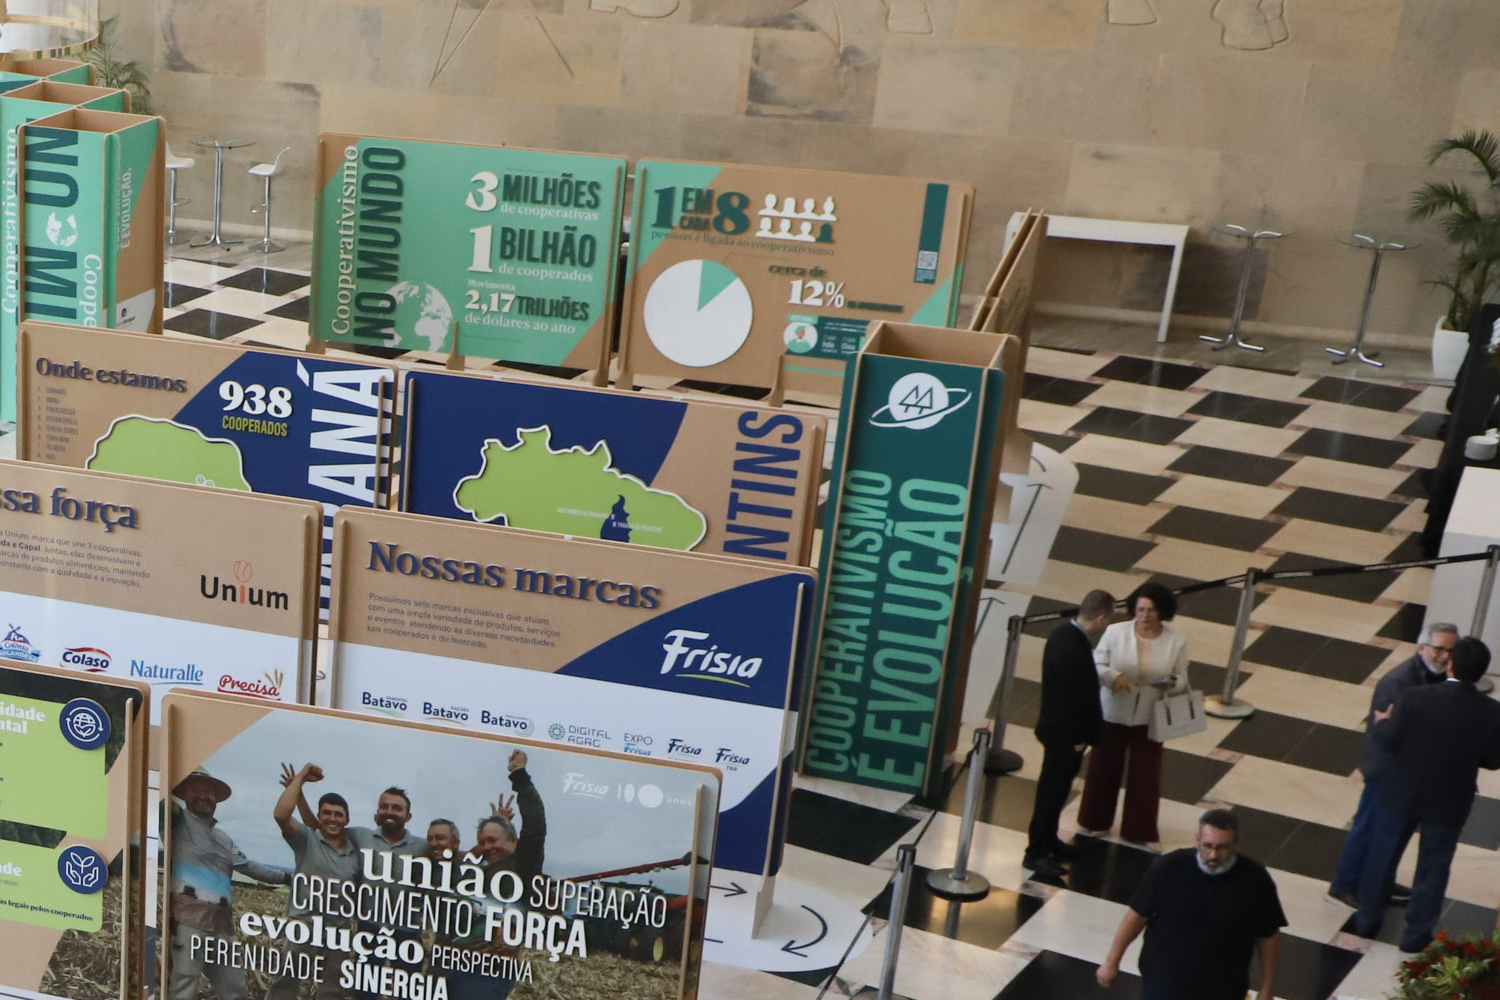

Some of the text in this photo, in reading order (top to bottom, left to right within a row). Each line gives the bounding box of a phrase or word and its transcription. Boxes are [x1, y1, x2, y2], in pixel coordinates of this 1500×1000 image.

[465, 171, 601, 211] 3 MILHÕES
[501, 203, 598, 221] de cooperativas
[651, 186, 676, 229] 1
[713, 191, 750, 235] 8
[331, 145, 358, 335] Cooperativismo
[354, 147, 406, 340] NO MUNDO
[468, 225, 597, 273] 1 BILHÃO
[499, 263, 593, 282] de cooperados
[465, 290, 590, 321] 2,17 TRILHÕES
[788, 279, 845, 308] 12%
[465, 313, 575, 334] de dólares ao ano
[36, 358, 187, 393] Onde estamos
[219, 380, 293, 418] 938
[222, 415, 288, 437] COOPERADOS
[50, 487, 138, 533] força
[200, 574, 289, 611] Unium
[366, 540, 663, 610] Nossas marcas
[805, 469, 892, 773] COOPERATIVISMO
[850, 478, 971, 787] É EVOLUÇÃO
[62, 652, 110, 669] Colaso
[130, 660, 204, 682] Naturalle
[219, 675, 280, 697] Precisa
[362, 692, 407, 711] Batavo
[423, 702, 469, 721] Batavo
[481, 710, 528, 730] Batavo
[568, 725, 612, 740] DIGITAL
[623, 733, 653, 746] EXPO
[359, 846, 668, 930] união SUPERAÇÃO
[8, 899, 29, 910] legais
[30, 904, 50, 913] pelos
[50, 907, 93, 921] cooperados
[292, 871, 588, 963] CRESCIMENTO FORÇA
[189, 934, 325, 984] PERENIDADE
[239, 911, 533, 984] evolução PERSPECTIVA
